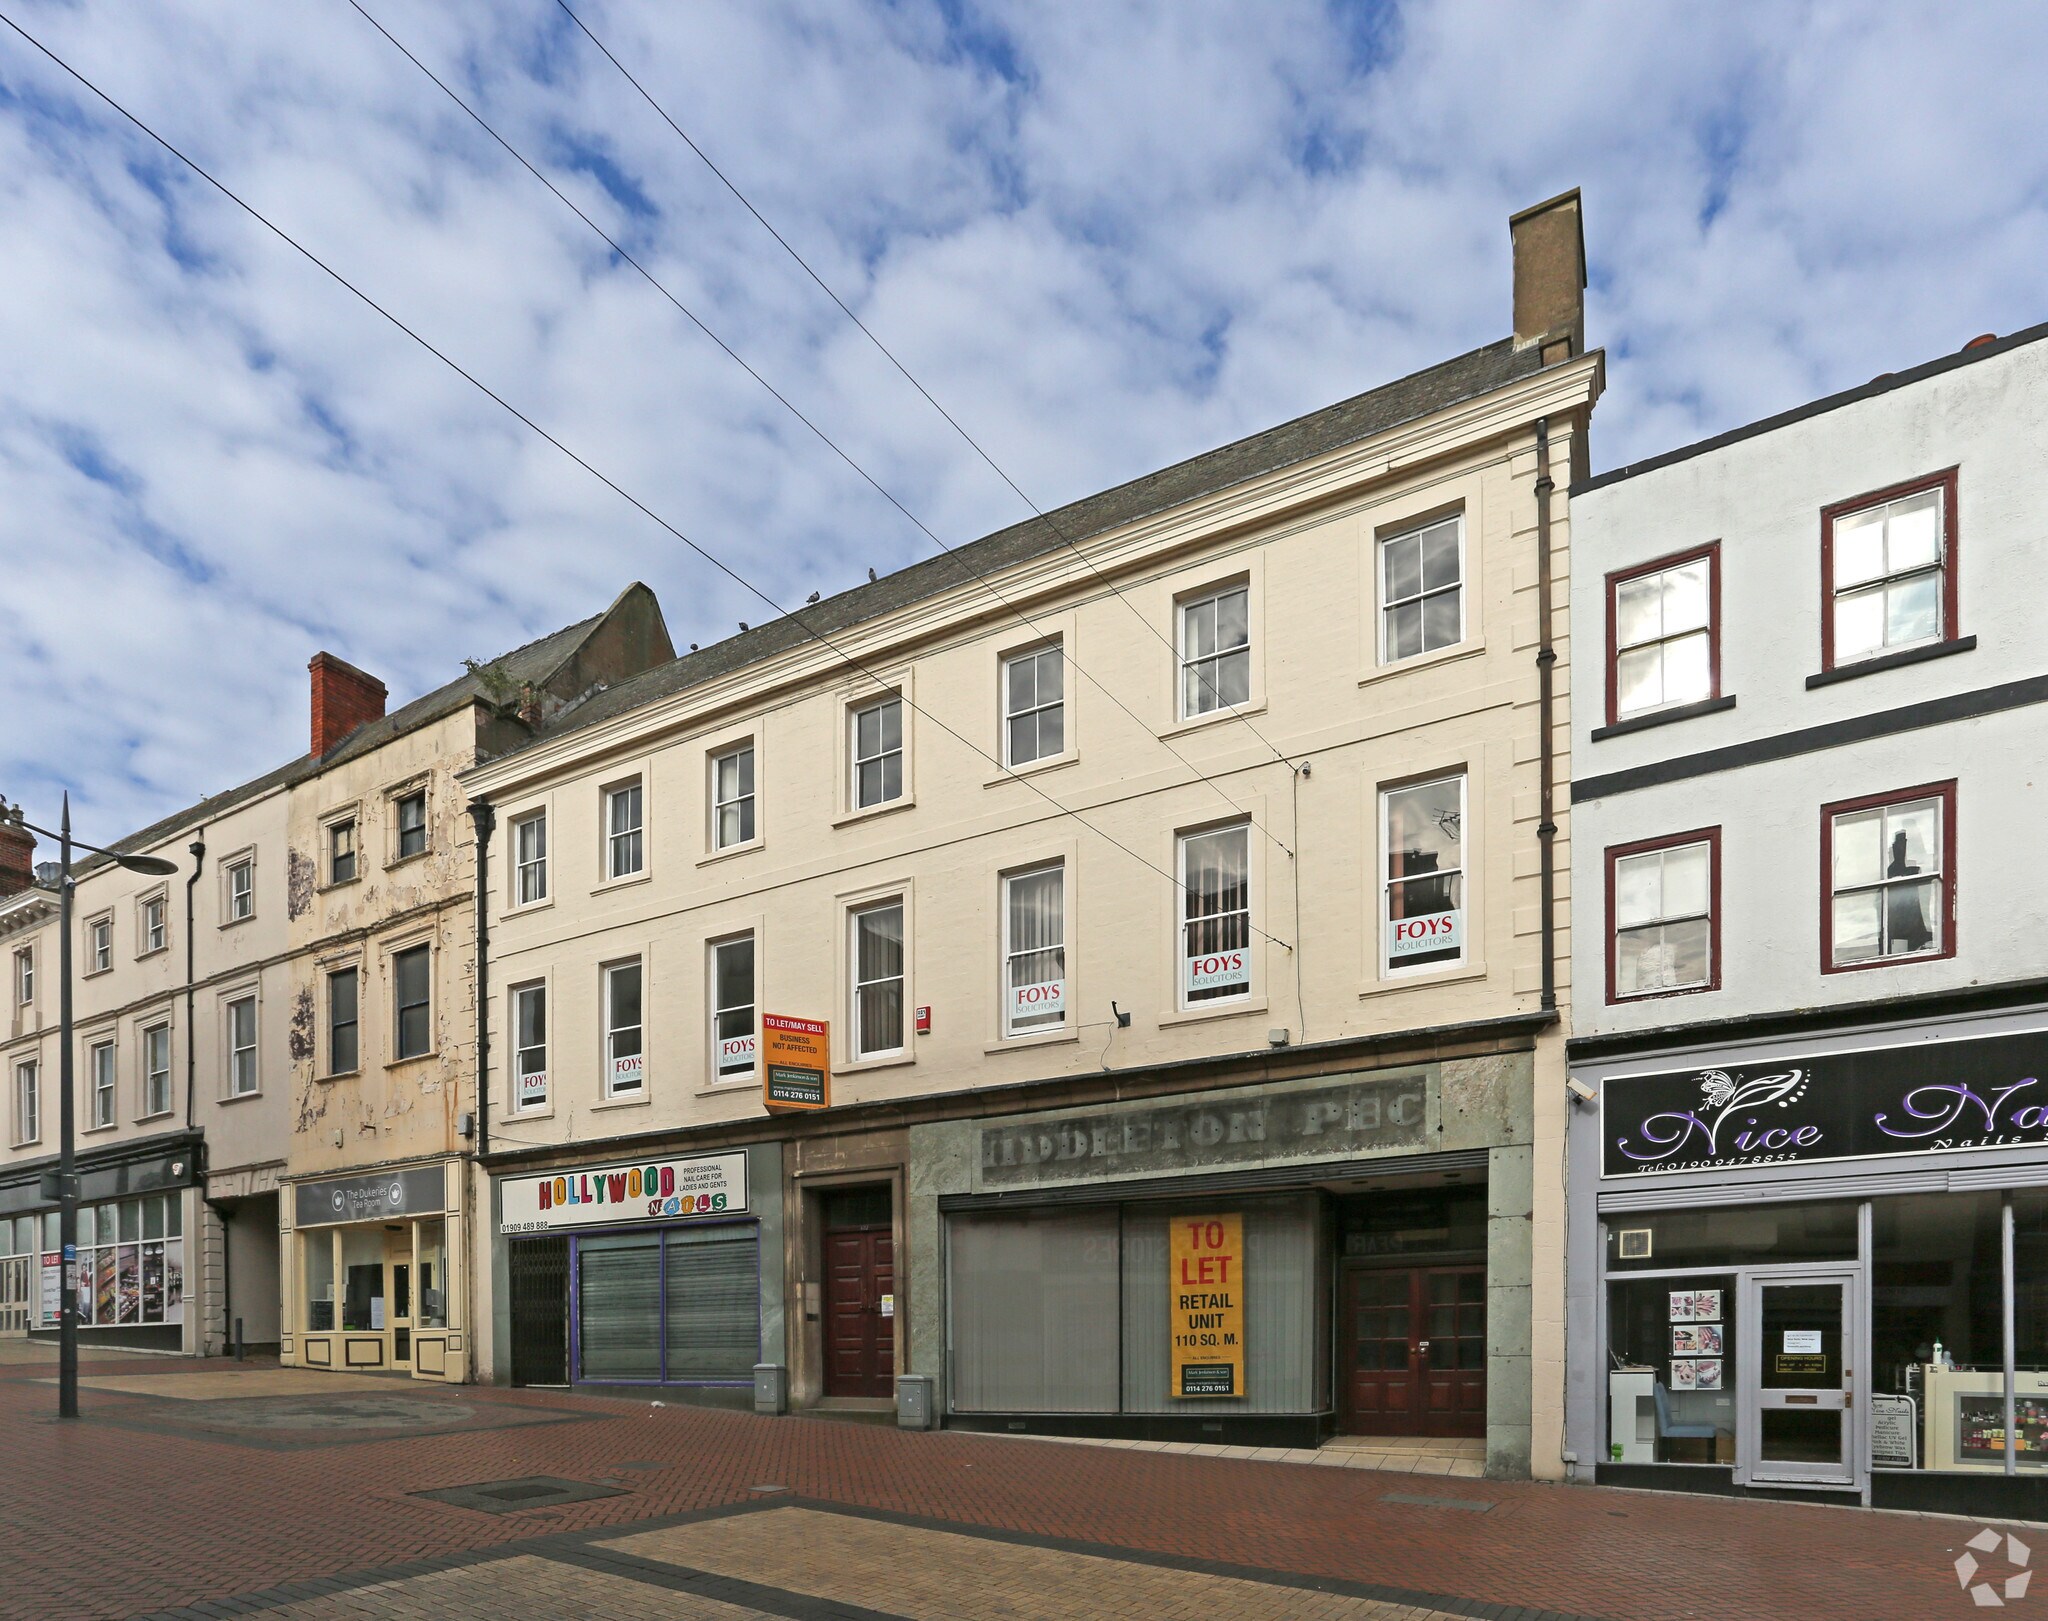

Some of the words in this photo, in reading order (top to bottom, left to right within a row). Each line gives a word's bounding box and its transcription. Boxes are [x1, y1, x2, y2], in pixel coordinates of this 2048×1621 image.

[1397, 915, 1453, 941] FOYS
[1397, 935, 1453, 951] SOLICITORS
[1193, 953, 1242, 976] FOYS
[1193, 971, 1242, 986] SOLICITORS
[1018, 983, 1061, 1005] FOYS
[1017, 1001, 1060, 1014] SOLICITORS
[765, 1017, 775, 1026] TO
[776, 1019, 806, 1031] LET/MAY
[807, 1023, 823, 1033] SELL
[724, 1038, 754, 1055] FOYS
[779, 1034, 810, 1044] BUSINESS
[772, 1041, 786, 1050] NOT
[787, 1043, 818, 1054] AFFECTED
[773, 1089, 789, 1098] 0114
[790, 1091, 803, 1099] 276
[804, 1093, 820, 1101] 0151
[1617, 1110, 1824, 1161] Nice
[1930, 1134, 2022, 1151] Nails
[683, 1164, 722, 1174] PROFESSIONAL
[696, 1174, 710, 1182] CARE
[711, 1172, 722, 1180] FOR
[346, 1190, 358, 1199] The
[359, 1186, 387, 1199] Dukeries
[538, 1166, 675, 1211] HOLLYWOOD
[679, 1183, 698, 1191] LADIES
[698, 1182, 709, 1190] AND
[709, 1180, 727, 1189] GENTS
[353, 1200, 363, 1209] Tea
[363, 1198, 381, 1208] Room
[649, 1194, 727, 1215] NAILS
[501, 1223, 521, 1232] 01909
[522, 1221, 535, 1231] 489
[536, 1220, 548, 1230] 888
[1187, 1220, 1224, 1250] TO
[44, 1256, 51, 1265] TO
[51, 1254, 59, 1264] LET
[1181, 1255, 1233, 1286] LET
[1180, 1293, 1234, 1310] RETAIL
[1188, 1313, 1225, 1329] UNIT
[1175, 1334, 1197, 1347] 110
[1200, 1333, 1220, 1346] SQ.
[1223, 1333, 1239, 1346] M.
